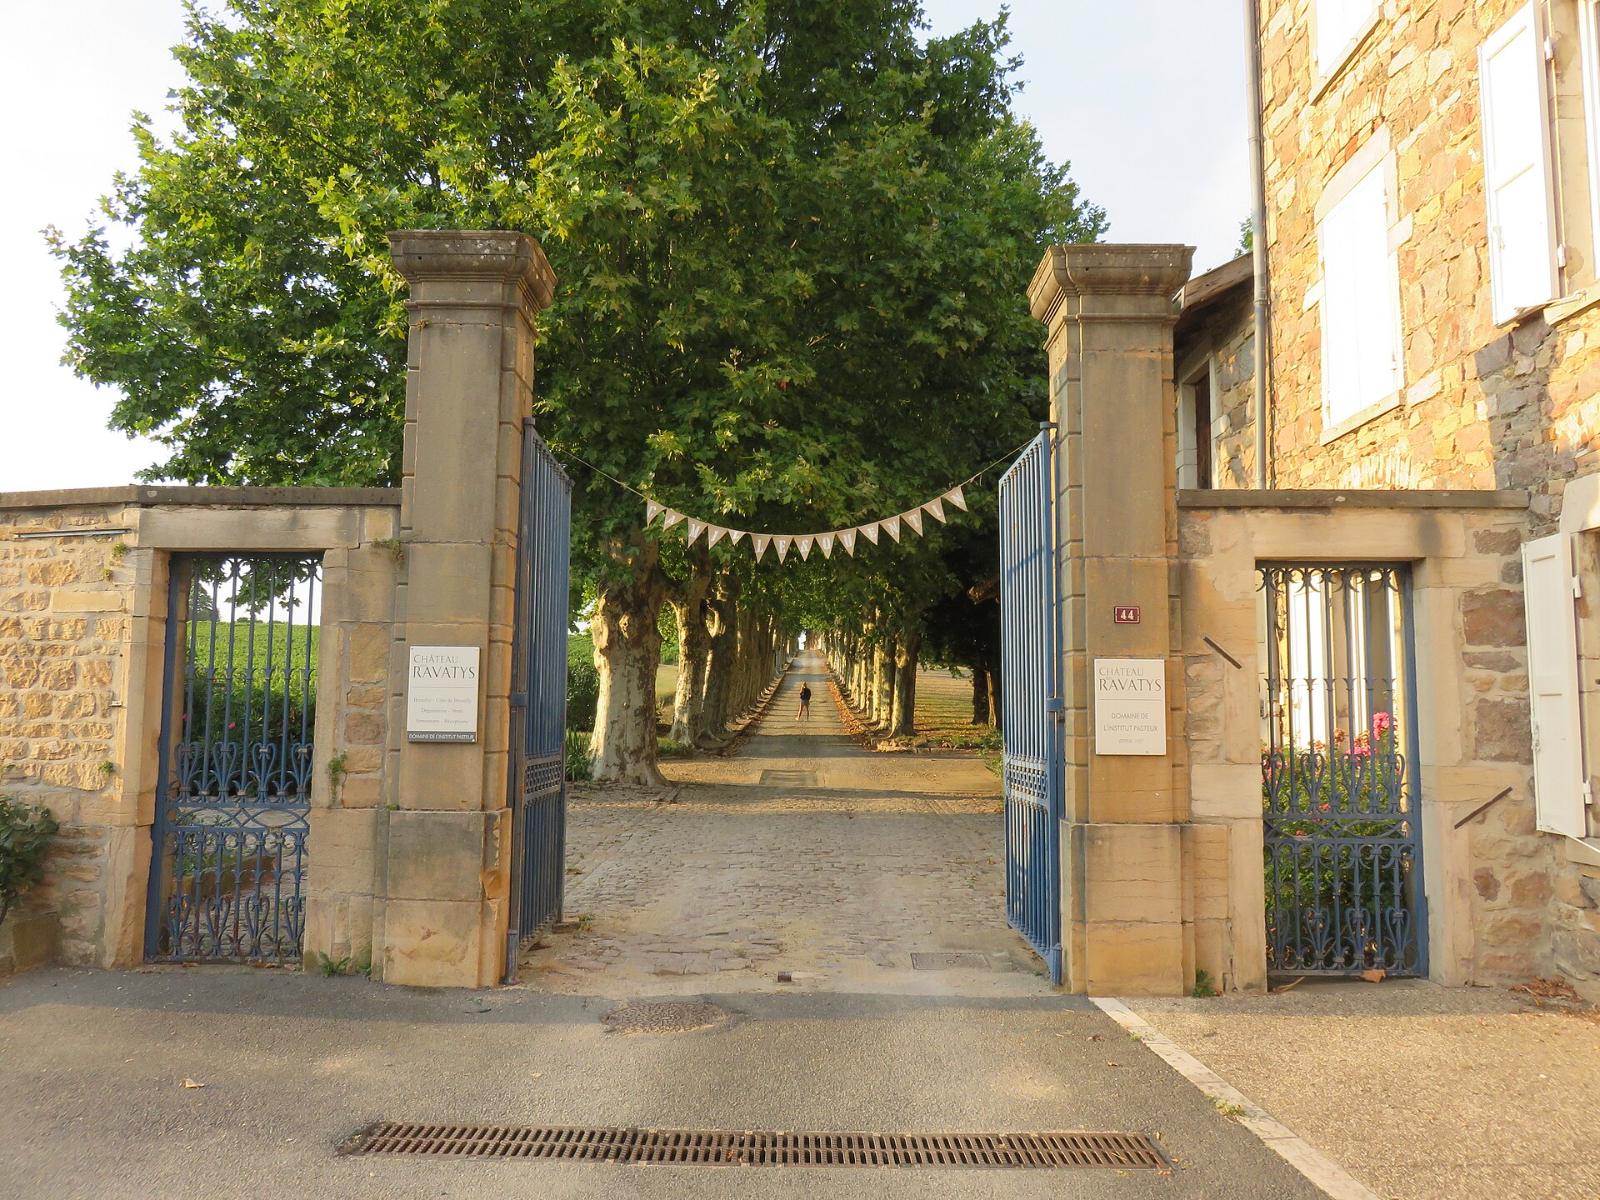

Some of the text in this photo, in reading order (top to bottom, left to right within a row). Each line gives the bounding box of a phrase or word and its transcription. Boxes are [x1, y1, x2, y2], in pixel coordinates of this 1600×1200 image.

[1120, 609, 1134, 620] 44
[413, 665, 475, 679] RAVATYS
[1099, 678, 1162, 692] RAVATYS
